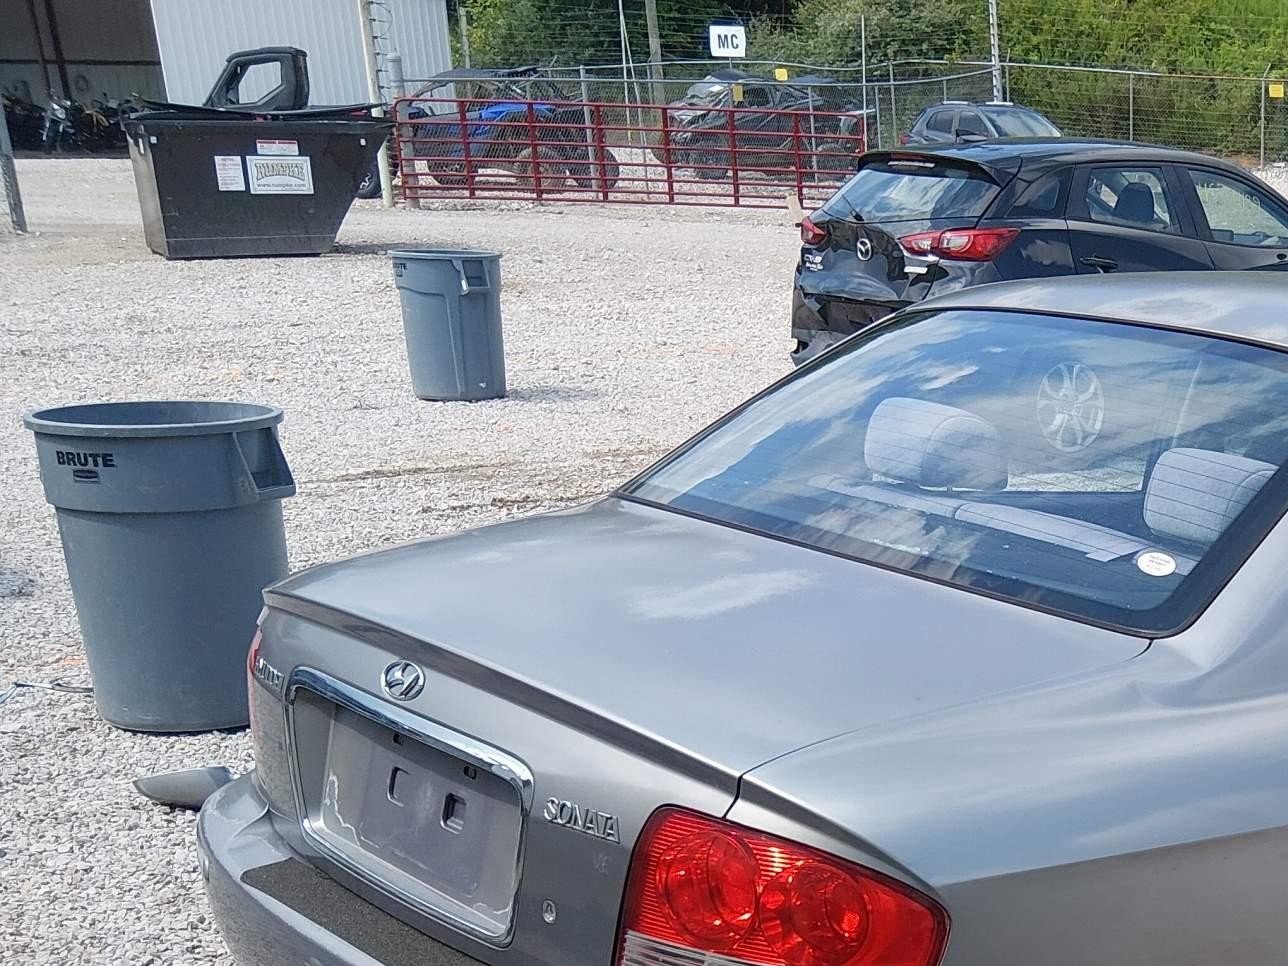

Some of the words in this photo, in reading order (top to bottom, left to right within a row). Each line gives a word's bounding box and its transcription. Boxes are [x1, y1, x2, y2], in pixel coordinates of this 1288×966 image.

[717, 34, 739, 49] MC
[56, 450, 115, 468] BRUTE
[543, 796, 621, 844] SONATA
